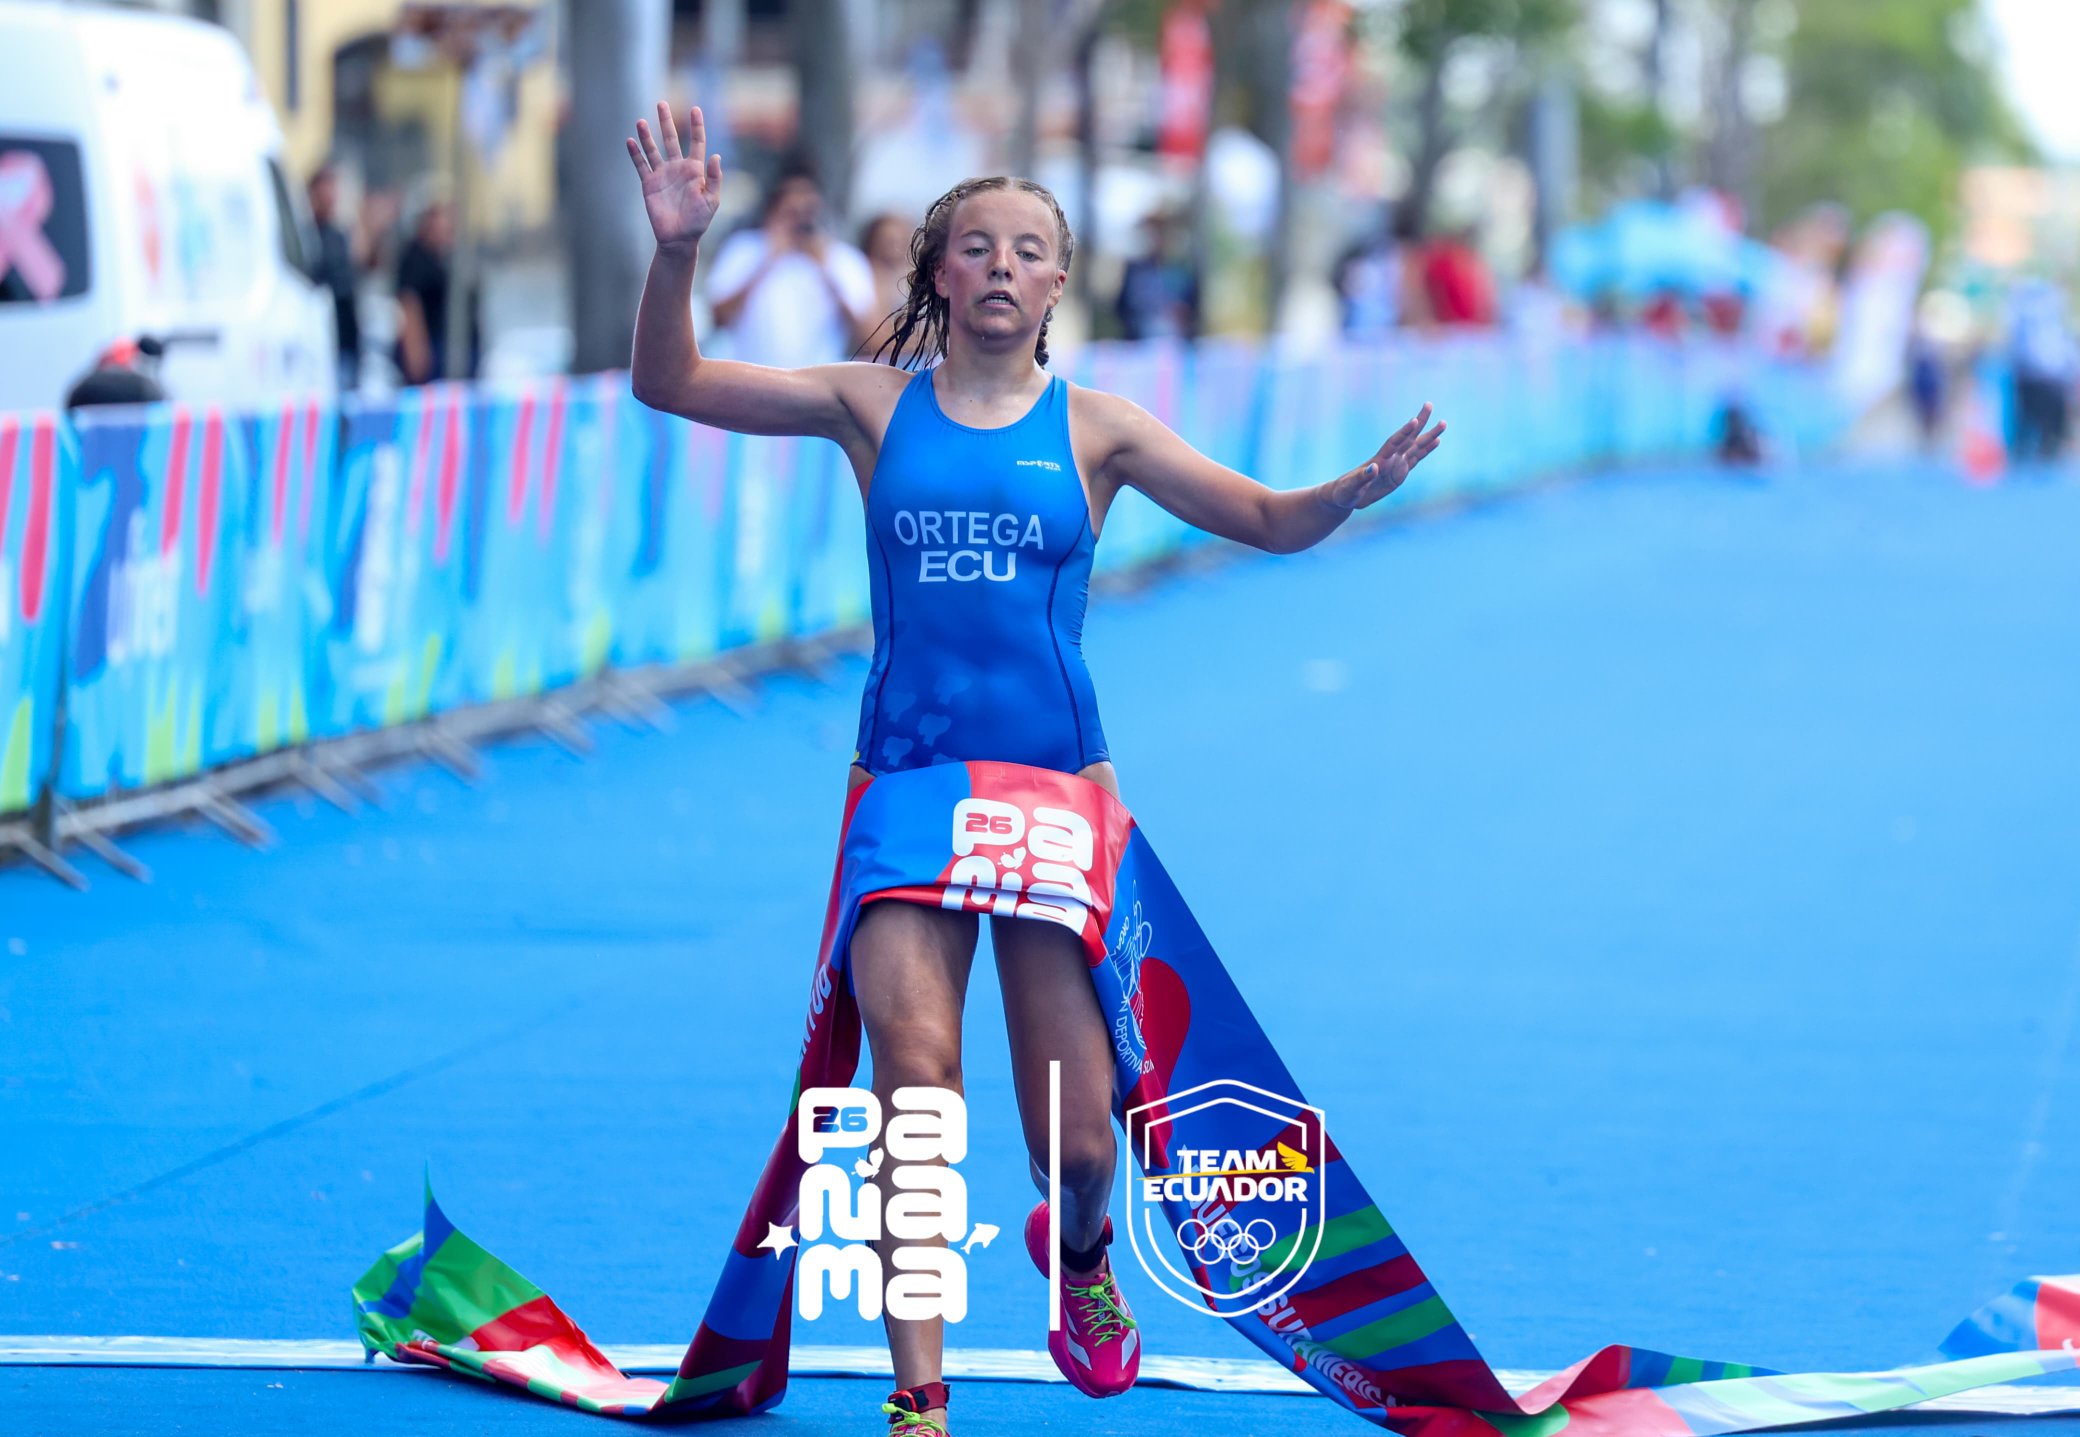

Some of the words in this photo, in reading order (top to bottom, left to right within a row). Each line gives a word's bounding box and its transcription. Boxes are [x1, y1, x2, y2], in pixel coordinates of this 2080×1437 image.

[894, 510, 1044, 550] ORTEGA
[918, 549, 1017, 583] ECU
[965, 812, 1013, 835] 26
